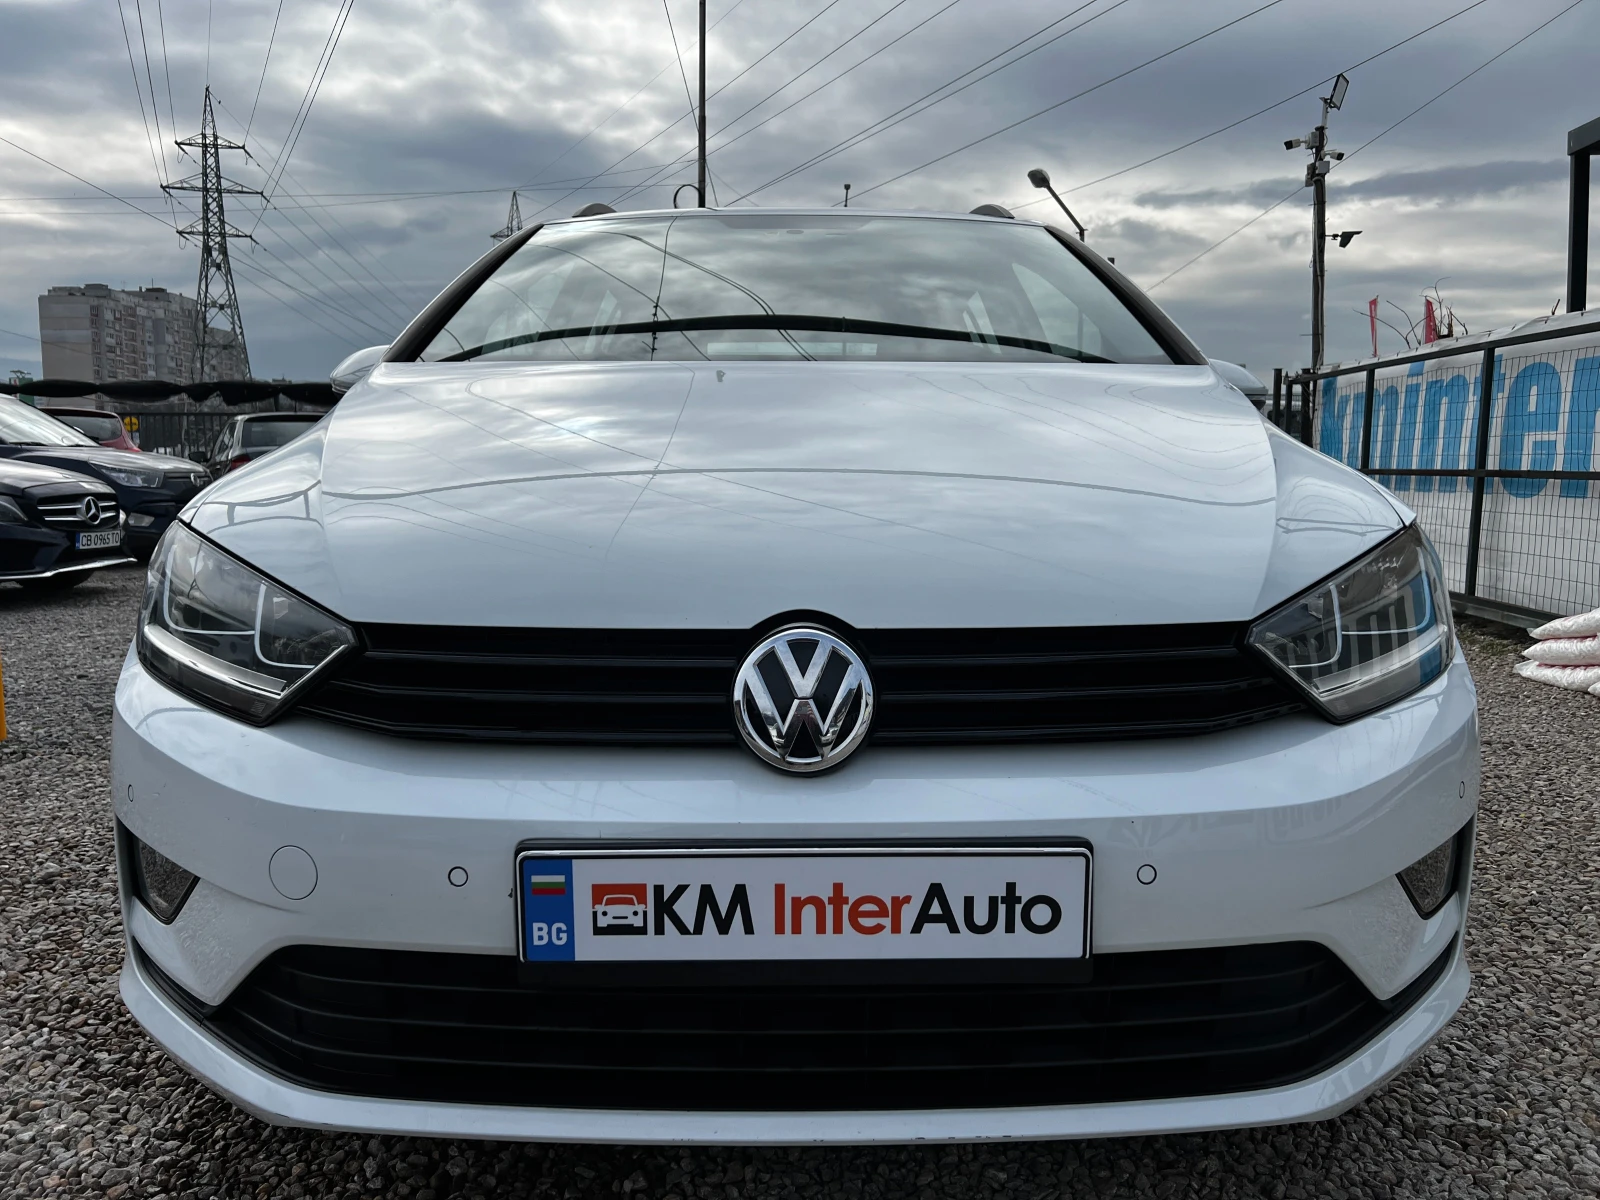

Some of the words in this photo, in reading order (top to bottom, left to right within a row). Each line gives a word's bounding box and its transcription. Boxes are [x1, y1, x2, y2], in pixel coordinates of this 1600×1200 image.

[81, 534, 92, 547] CB
[93, 532, 111, 546] 0965
[735, 629, 873, 772] VW
[653, 883, 755, 936] KM
[774, 882, 1062, 935] InterAuto
[532, 922, 567, 946] BG
